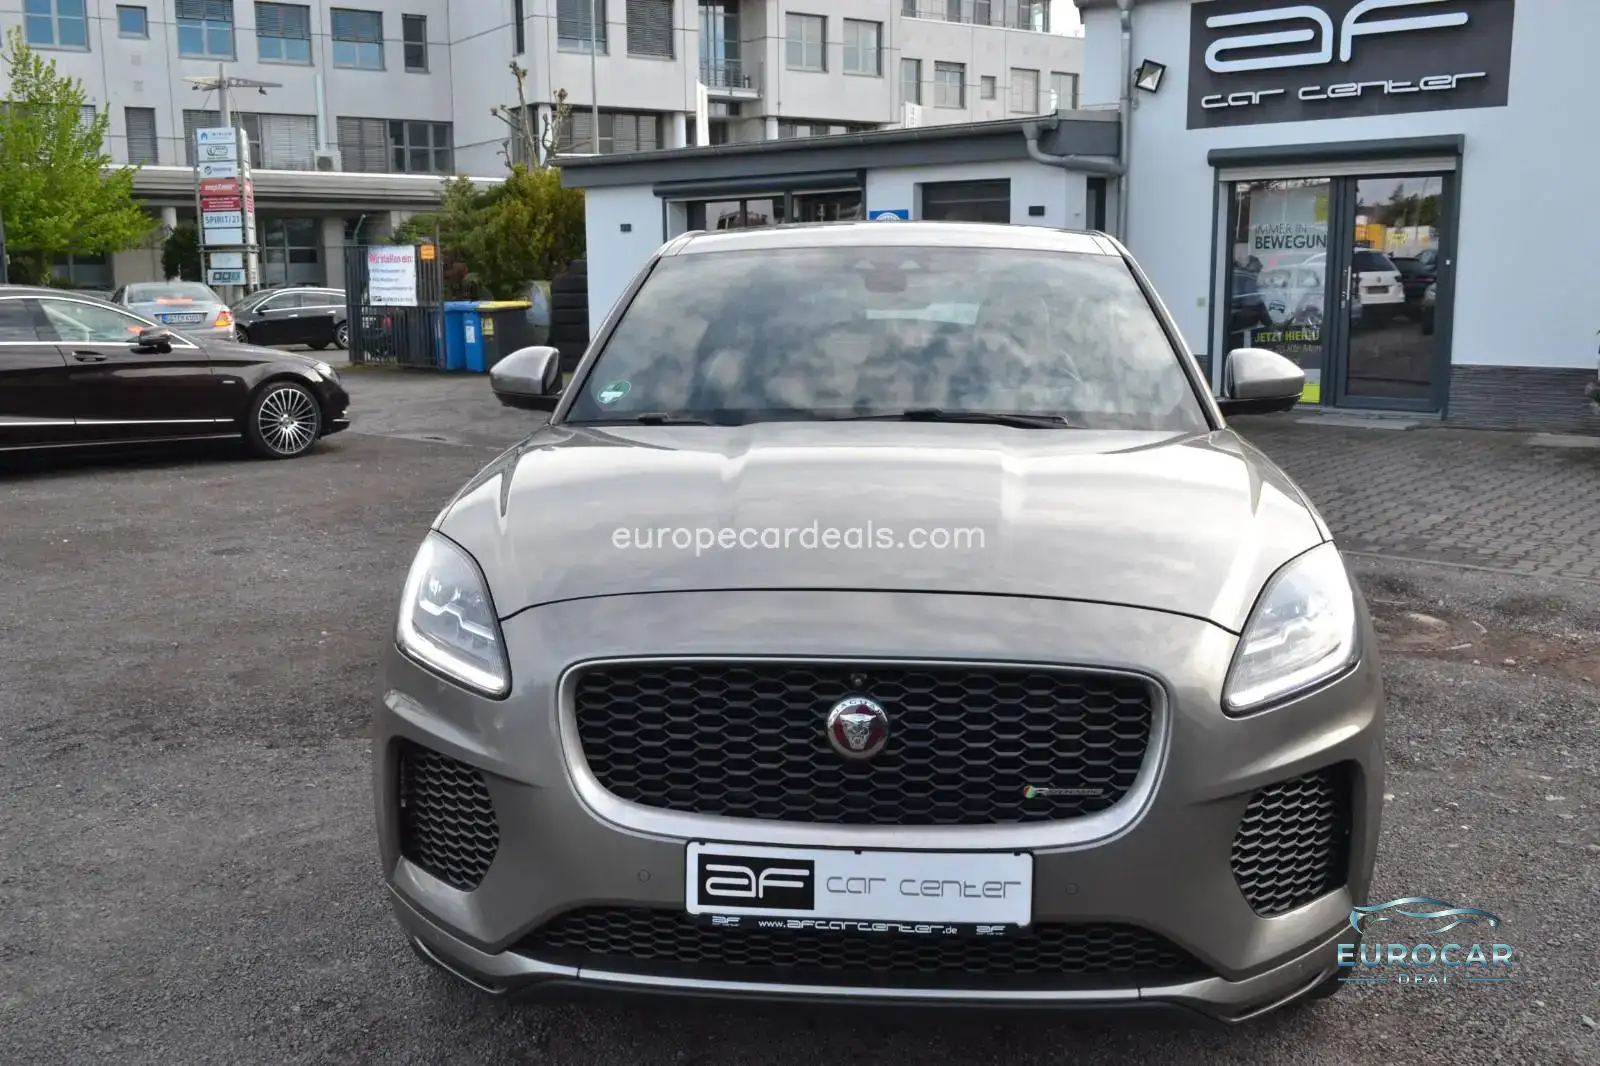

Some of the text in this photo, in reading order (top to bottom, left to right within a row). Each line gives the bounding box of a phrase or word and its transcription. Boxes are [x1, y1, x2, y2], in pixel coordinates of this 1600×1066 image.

[1201, 71, 1487, 109] car center
[1255, 223, 1292, 235] IMMER
[1255, 331, 1282, 342] JETZT
[826, 876, 1021, 899] car center
[758, 919, 958, 935] www.afcarcenter.de
